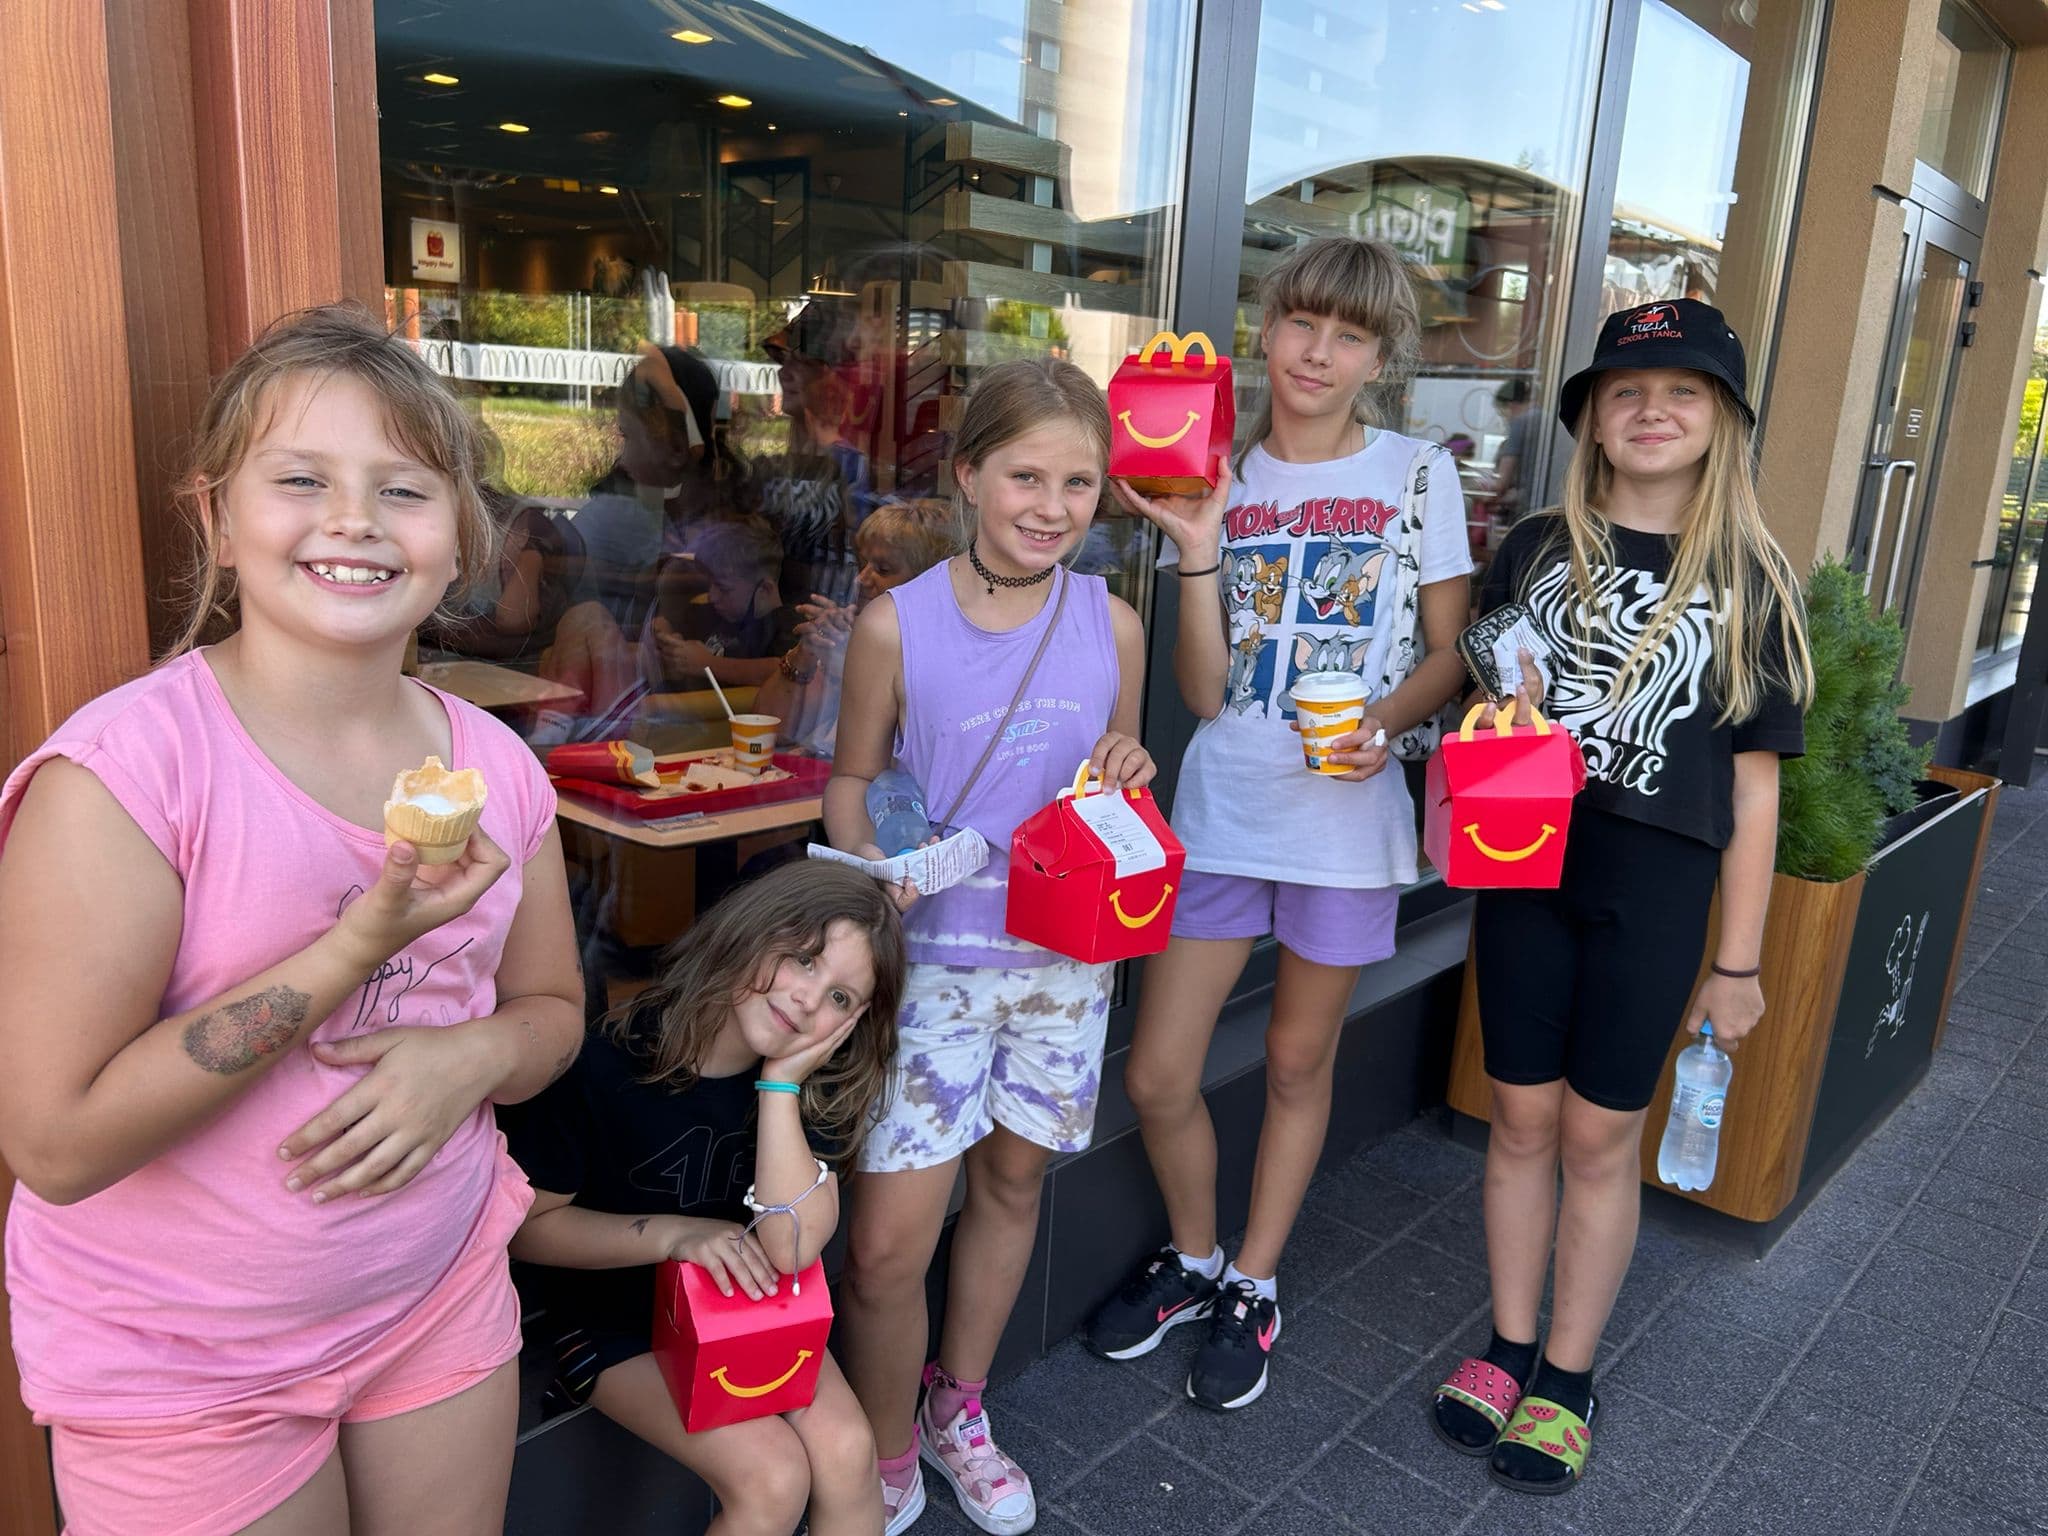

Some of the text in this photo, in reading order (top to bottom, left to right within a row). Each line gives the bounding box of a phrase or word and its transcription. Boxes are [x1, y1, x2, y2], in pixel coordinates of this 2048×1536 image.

[1223, 500, 1280, 542] TOM
[1287, 496, 1400, 539] JERRY
[992, 700, 1032, 719] COES
[1035, 698, 1057, 710] THE
[1058, 699, 1081, 713] SUN
